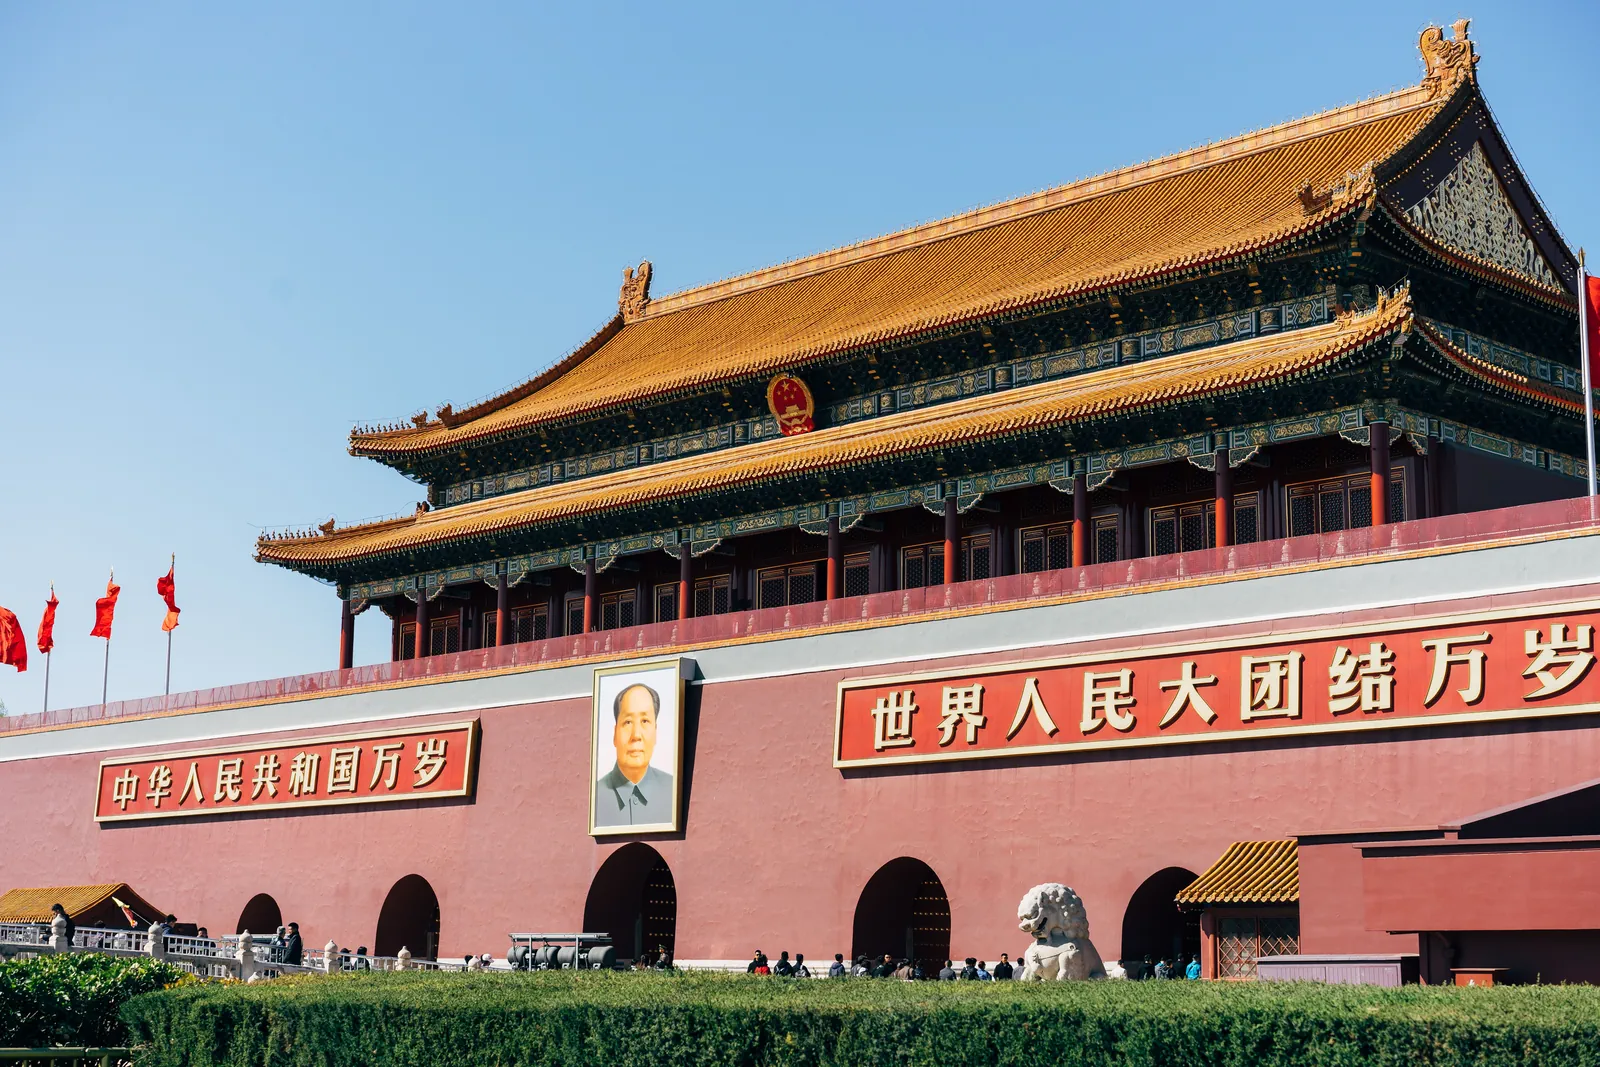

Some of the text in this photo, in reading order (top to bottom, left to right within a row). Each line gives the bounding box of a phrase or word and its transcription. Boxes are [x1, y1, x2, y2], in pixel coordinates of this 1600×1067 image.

[870, 624, 1595, 751] 世界人民大团结万岁
[112, 738, 448, 810] 中华人民共和国万岁
